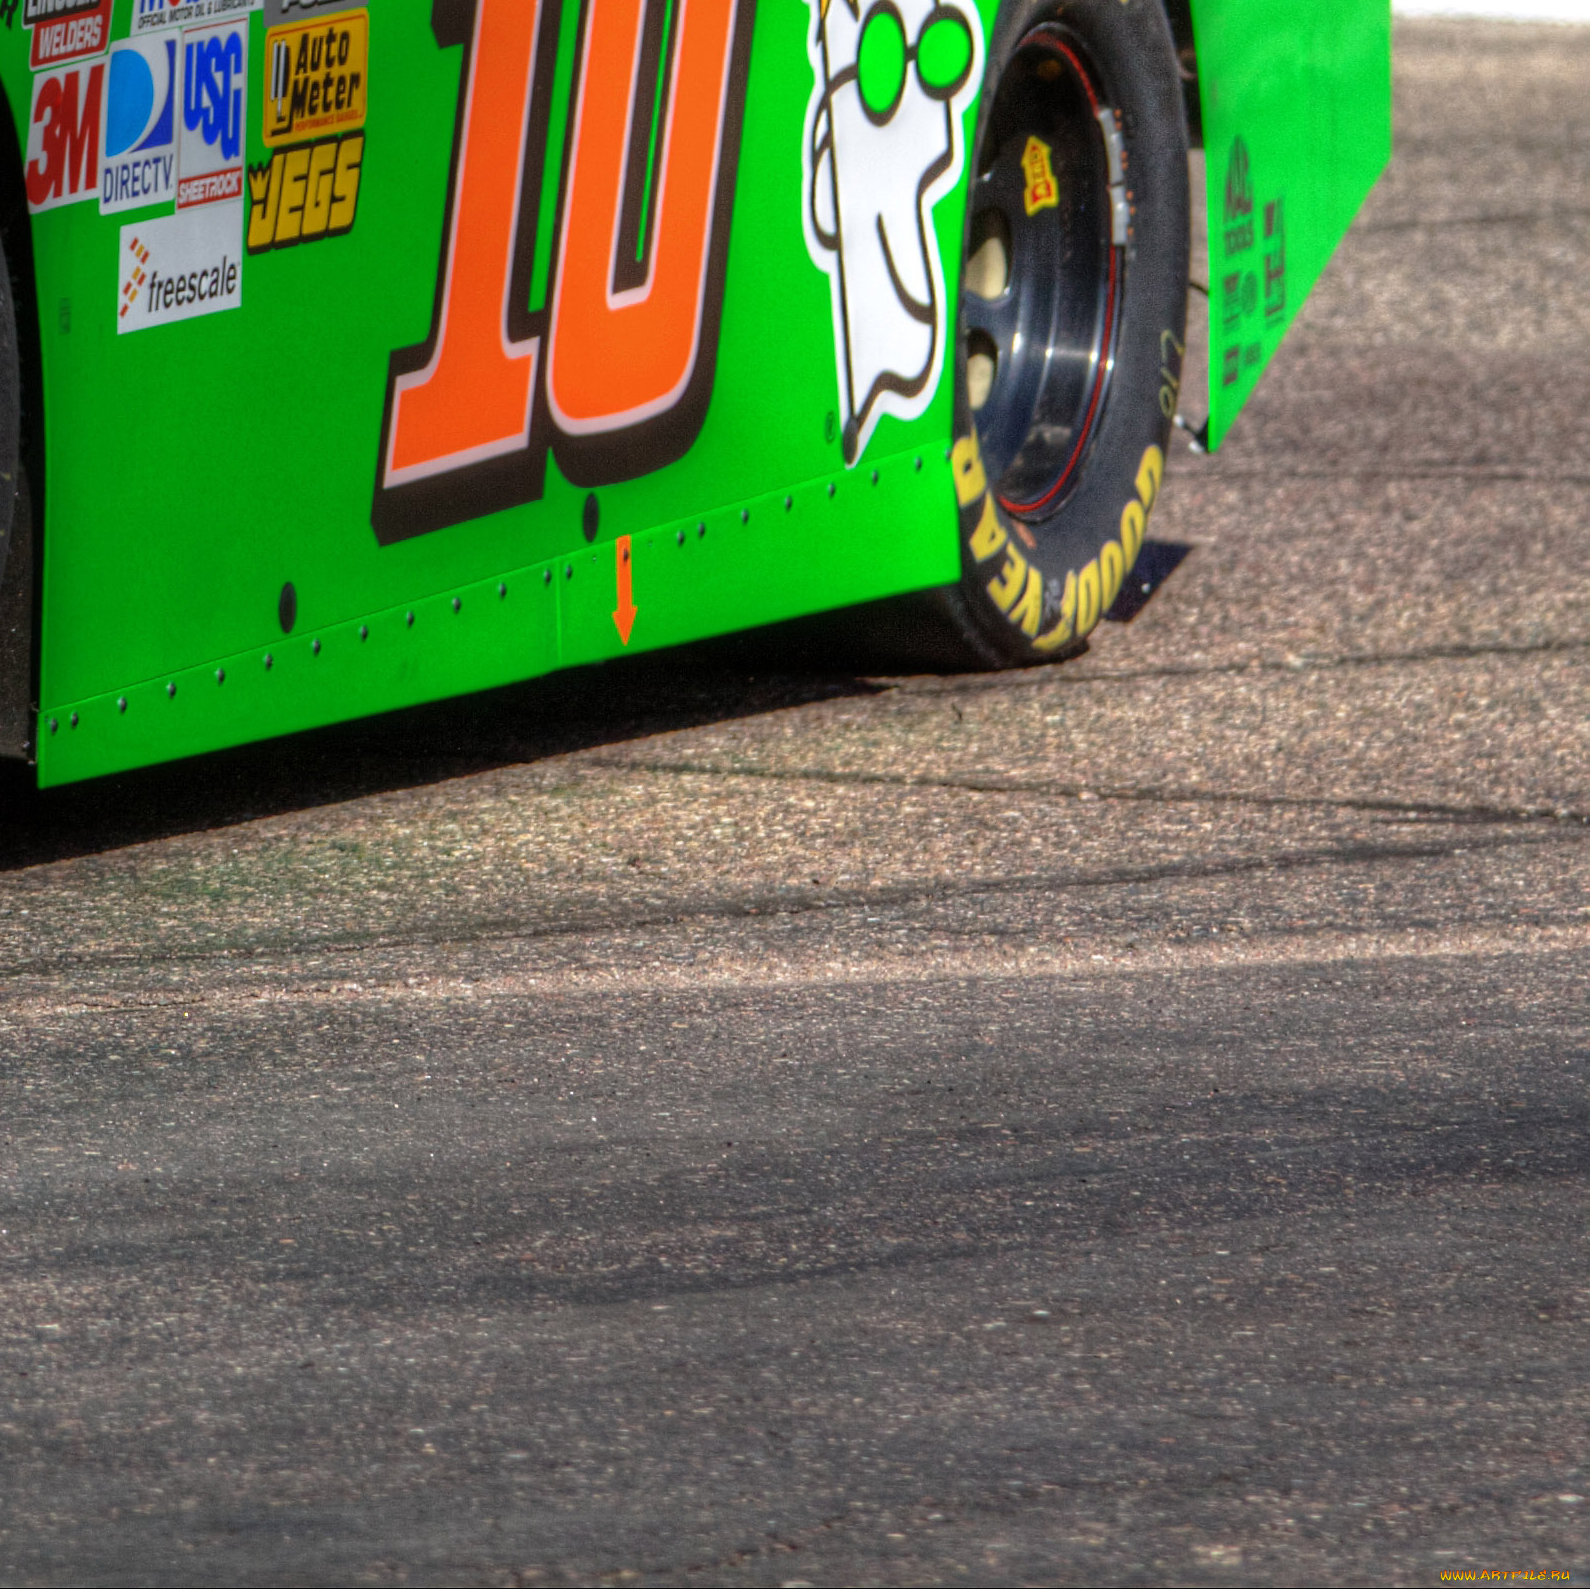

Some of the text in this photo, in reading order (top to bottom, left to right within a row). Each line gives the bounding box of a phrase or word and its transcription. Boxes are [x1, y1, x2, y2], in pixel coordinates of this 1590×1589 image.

[38, 14, 103, 60] WELDERS
[294, 27, 350, 76] Auto
[183, 31, 243, 161] USG
[292, 72, 361, 120] Meter
[25, 63, 106, 205] 3M
[178, 174, 240, 203] SHEETROCK
[247, 128, 365, 255] JEGS
[148, 255, 238, 313] freescale
